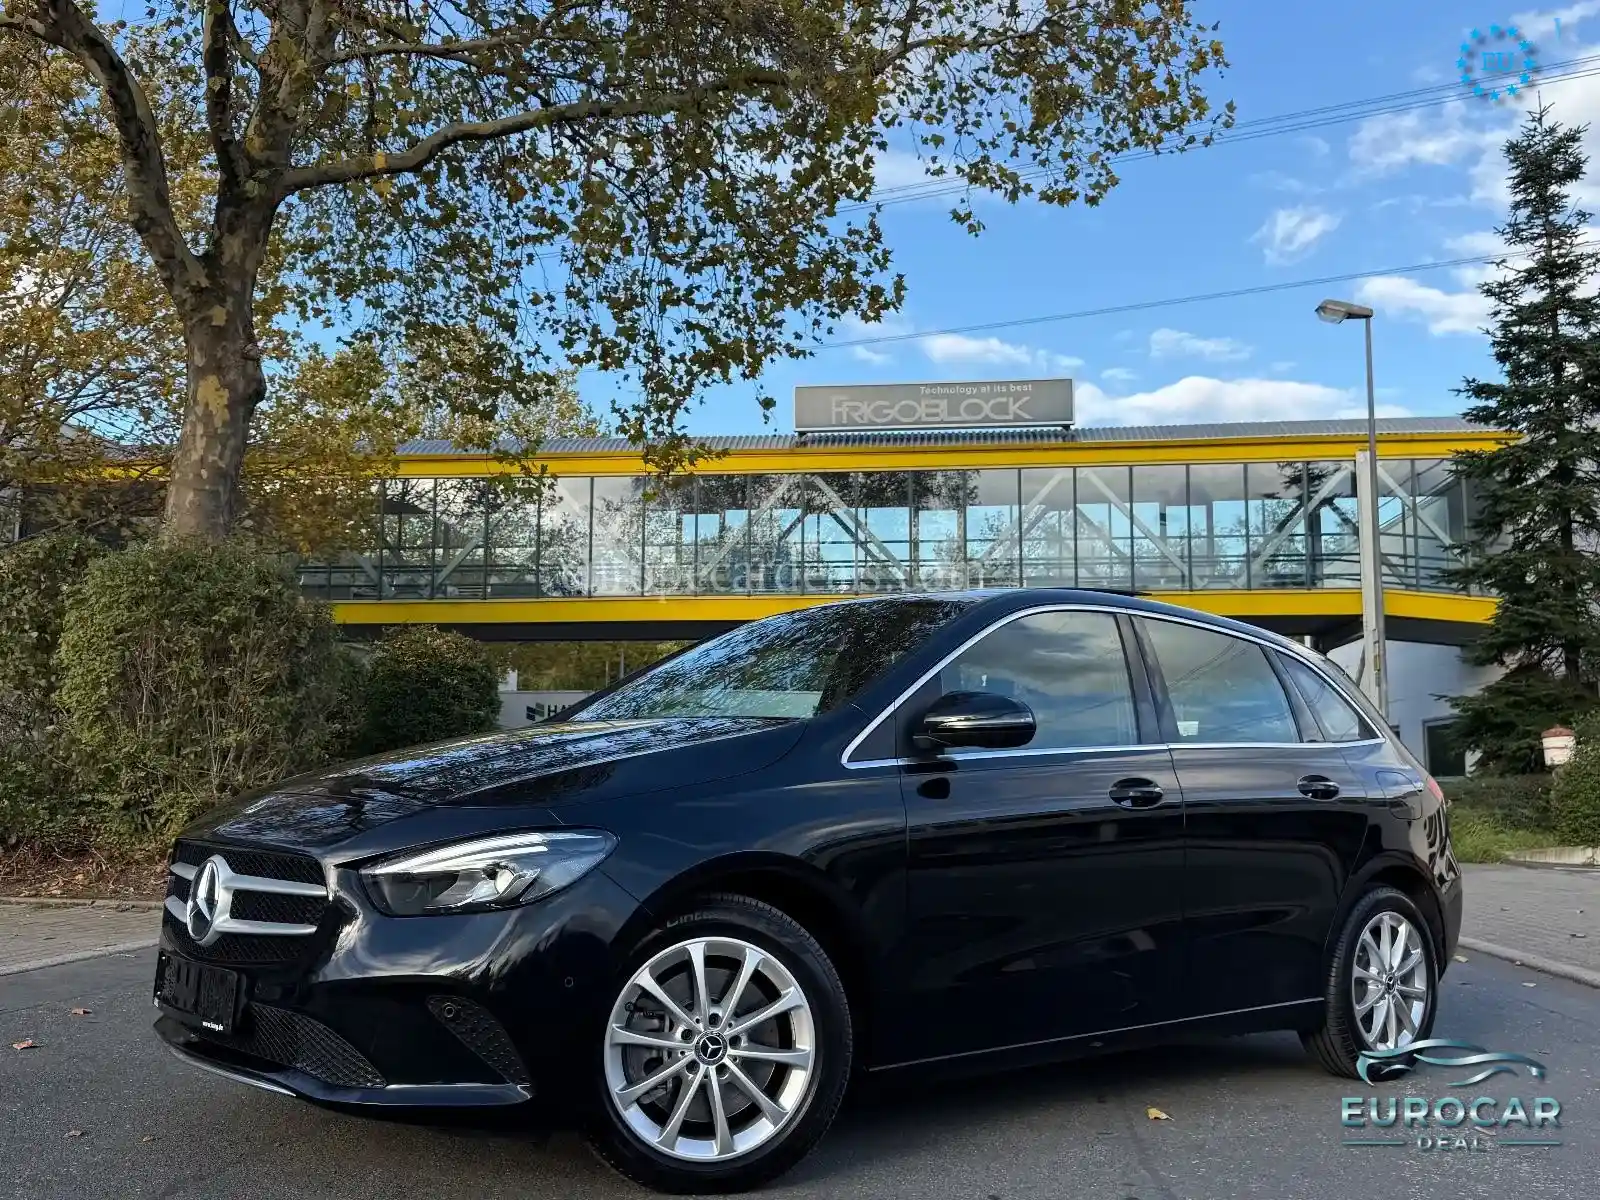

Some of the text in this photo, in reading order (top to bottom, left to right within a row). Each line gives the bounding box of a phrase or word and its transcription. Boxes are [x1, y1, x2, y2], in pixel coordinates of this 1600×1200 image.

[919, 383, 1033, 395] Technology at its best
[831, 396, 1034, 424] FRIGOBLOCK
